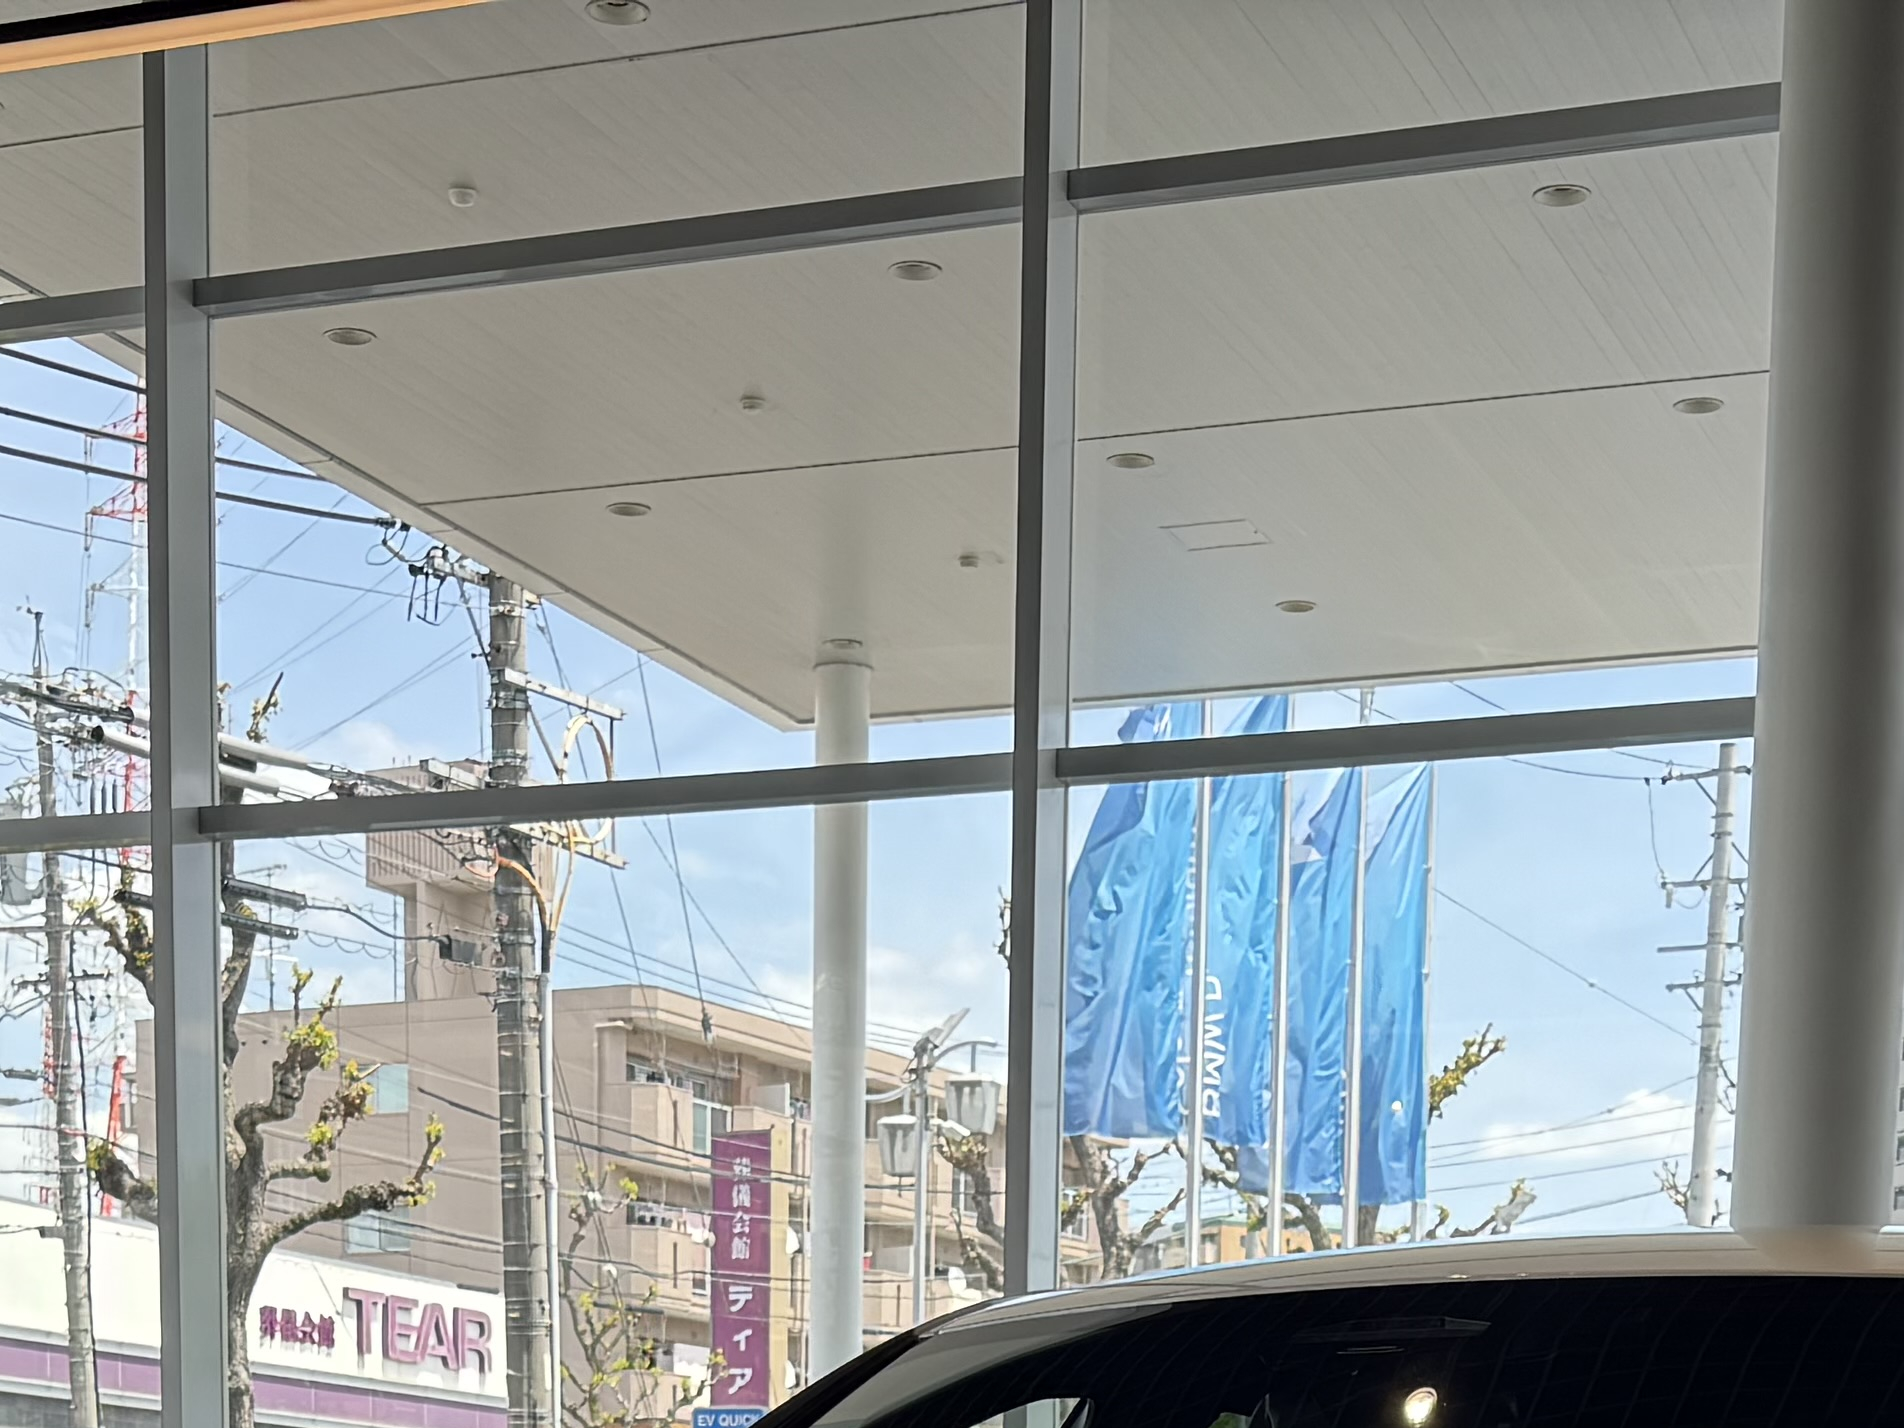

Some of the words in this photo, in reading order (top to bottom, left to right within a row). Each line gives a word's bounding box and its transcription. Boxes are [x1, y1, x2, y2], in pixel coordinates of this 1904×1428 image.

[342, 1286, 494, 1374] TEAR
[728, 1286, 753, 1395] ティア
[698, 1414, 715, 1427] EV
